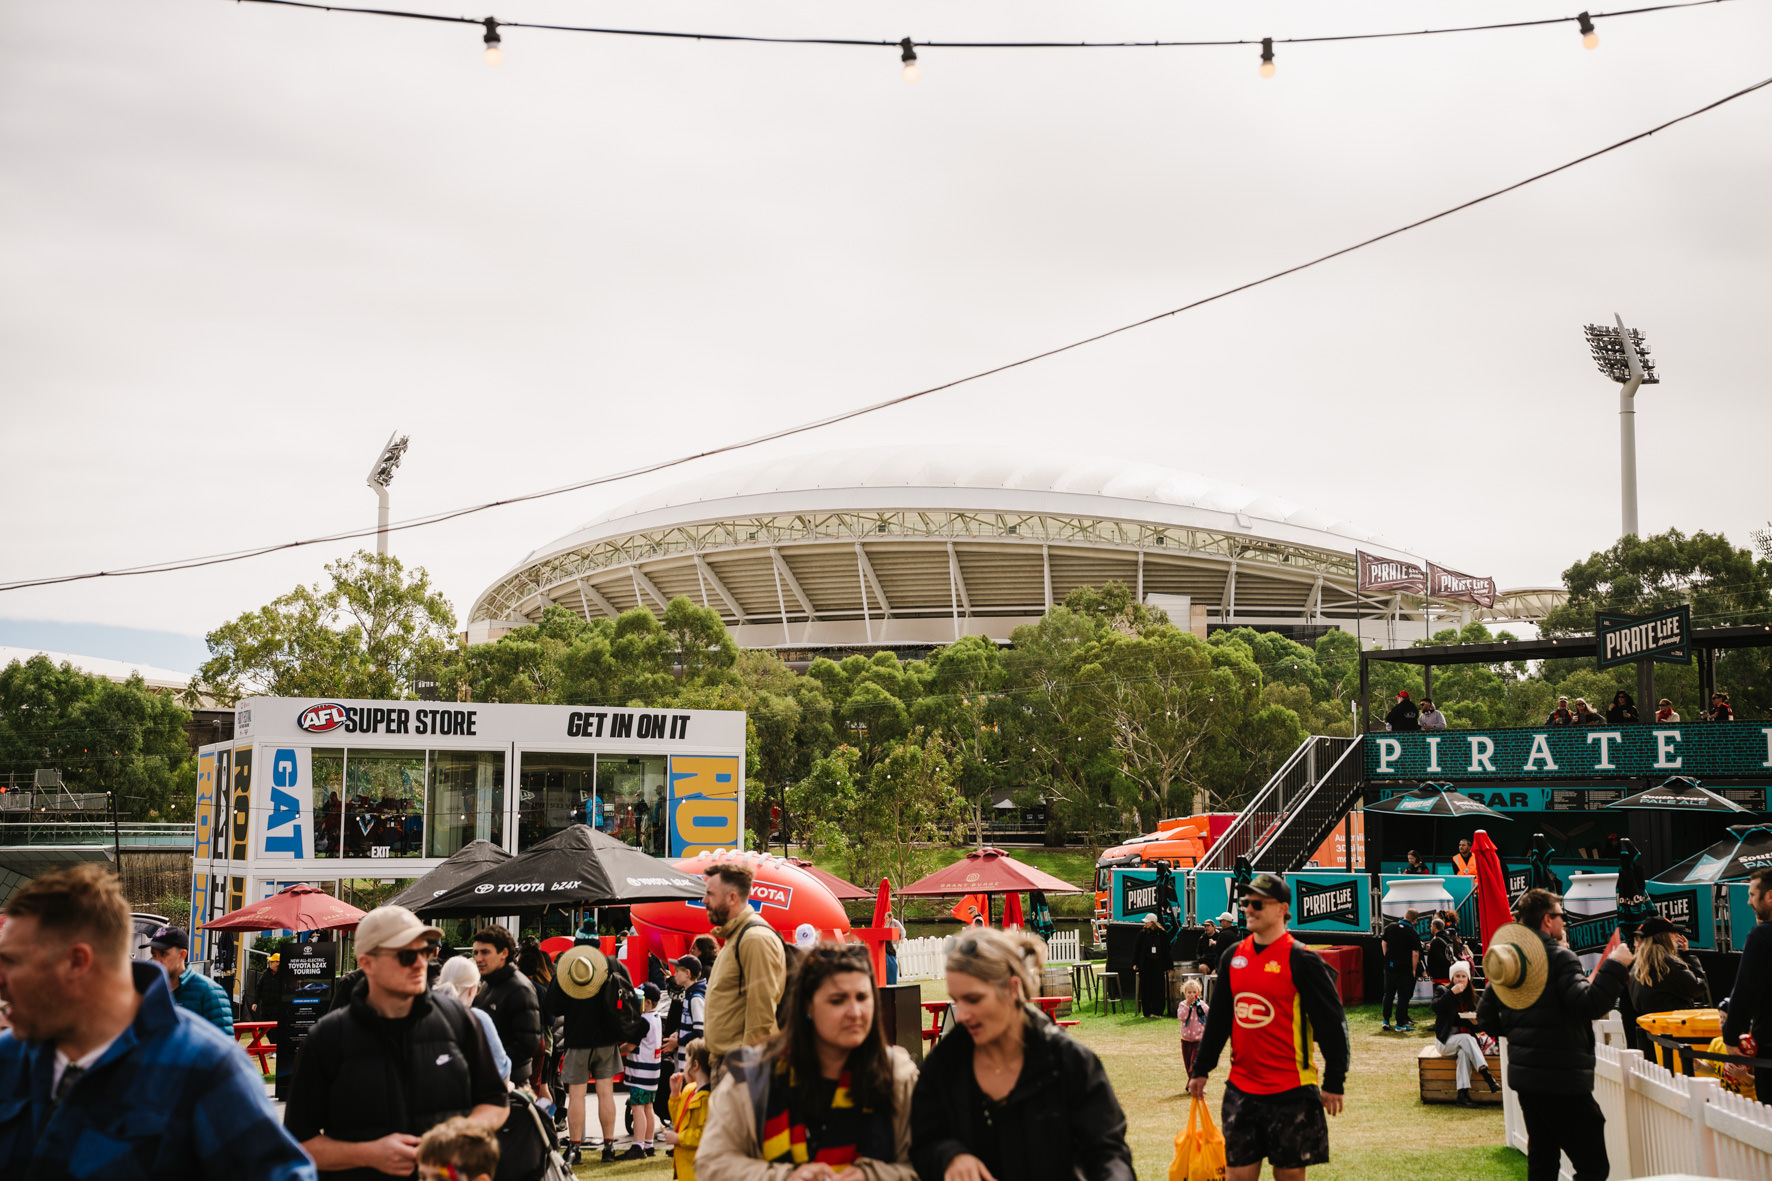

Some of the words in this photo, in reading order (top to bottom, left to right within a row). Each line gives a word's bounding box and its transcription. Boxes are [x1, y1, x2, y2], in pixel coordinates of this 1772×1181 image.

[302, 708, 348, 729] AFL
[344, 707, 410, 734] SUPER
[415, 709, 477, 736] STORE
[567, 711, 608, 737] GET
[610, 713, 634, 738] IN
[637, 713, 667, 739] ON
[669, 715, 691, 739] IT
[1376, 729, 1683, 773] PIRATE
[1467, 792, 1528, 807] BAR
[371, 846, 391, 858] EXIT
[497, 883, 545, 893] TOYOTA
[551, 880, 582, 891] bZ4X
[1237, 1002, 1270, 1021] GC
